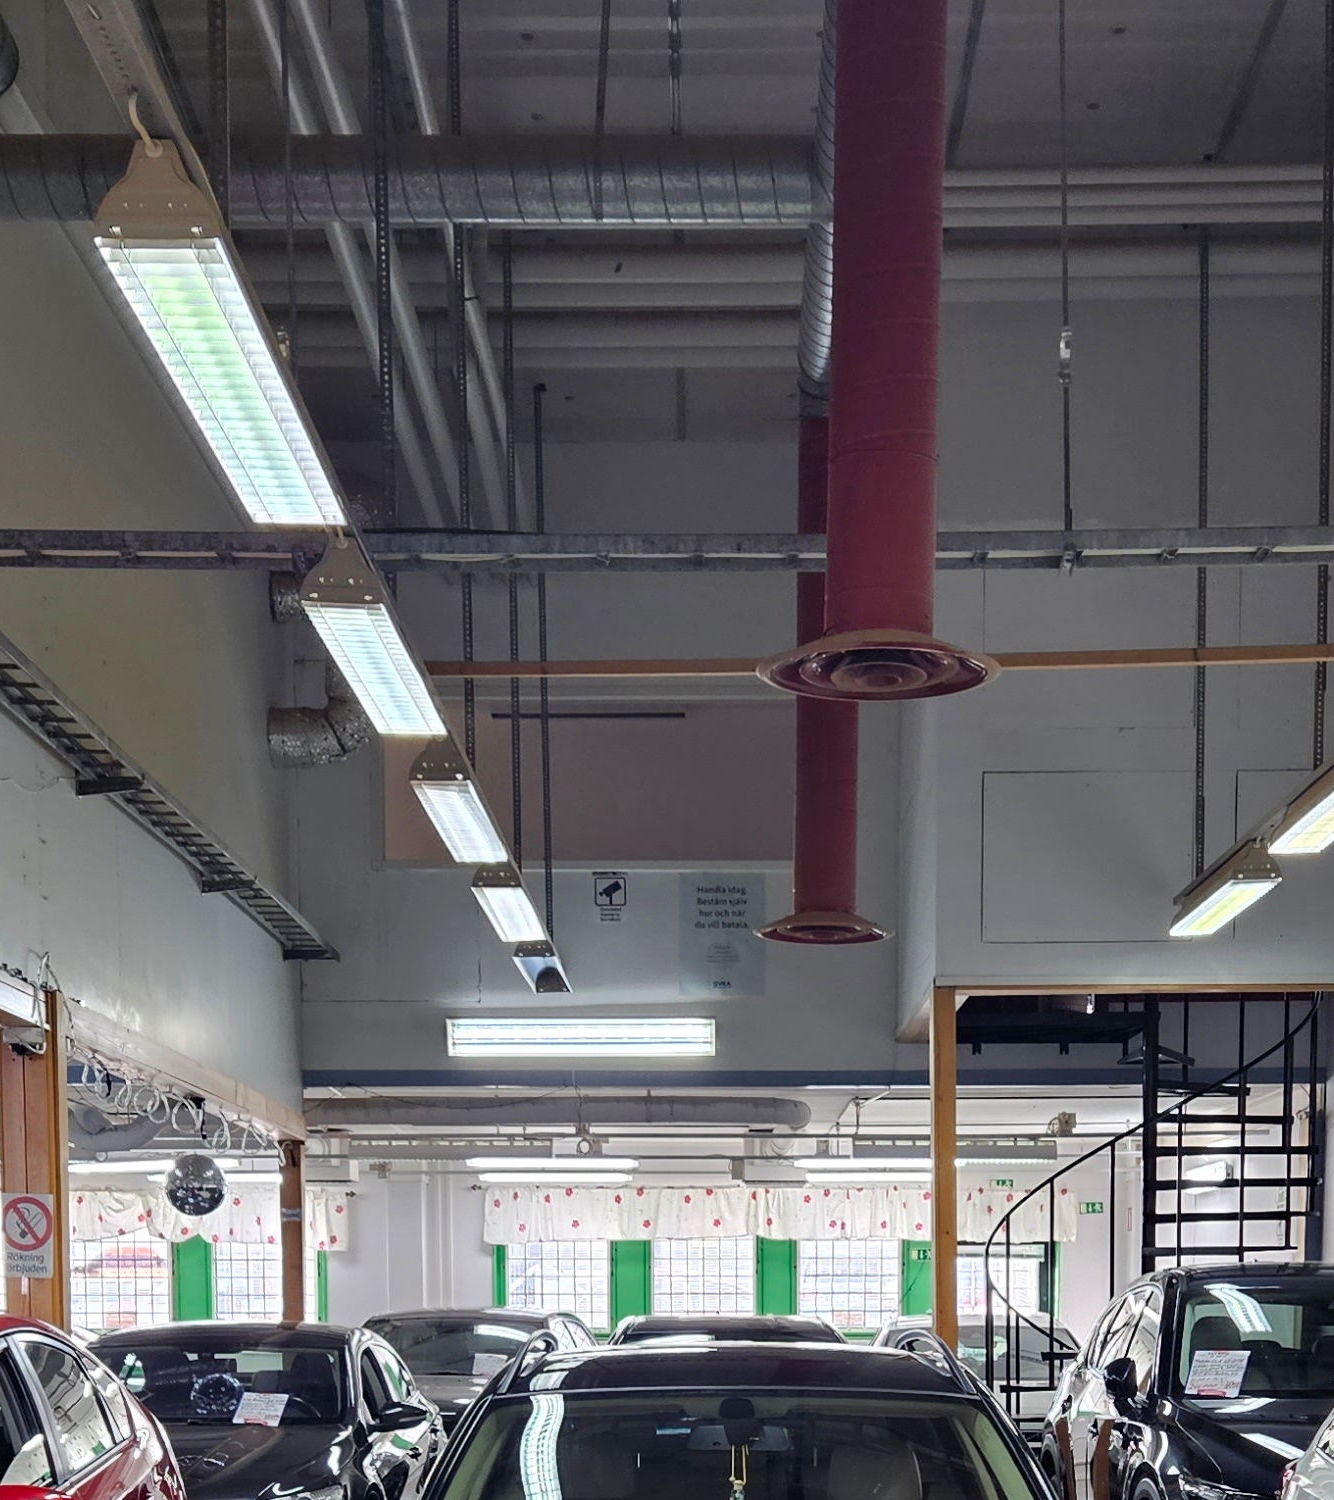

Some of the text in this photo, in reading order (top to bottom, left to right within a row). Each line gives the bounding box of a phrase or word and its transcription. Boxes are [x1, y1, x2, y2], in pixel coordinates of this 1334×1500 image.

[697, 885, 726, 894] Handla
[697, 897, 727, 906] Bestäm
[699, 908, 745, 917] hur och när
[695, 920, 706, 929] du
[707, 920, 720, 929] vill
[7, 1252, 44, 1264] Rökning
[6, 1263, 48, 1274] örbjuden
